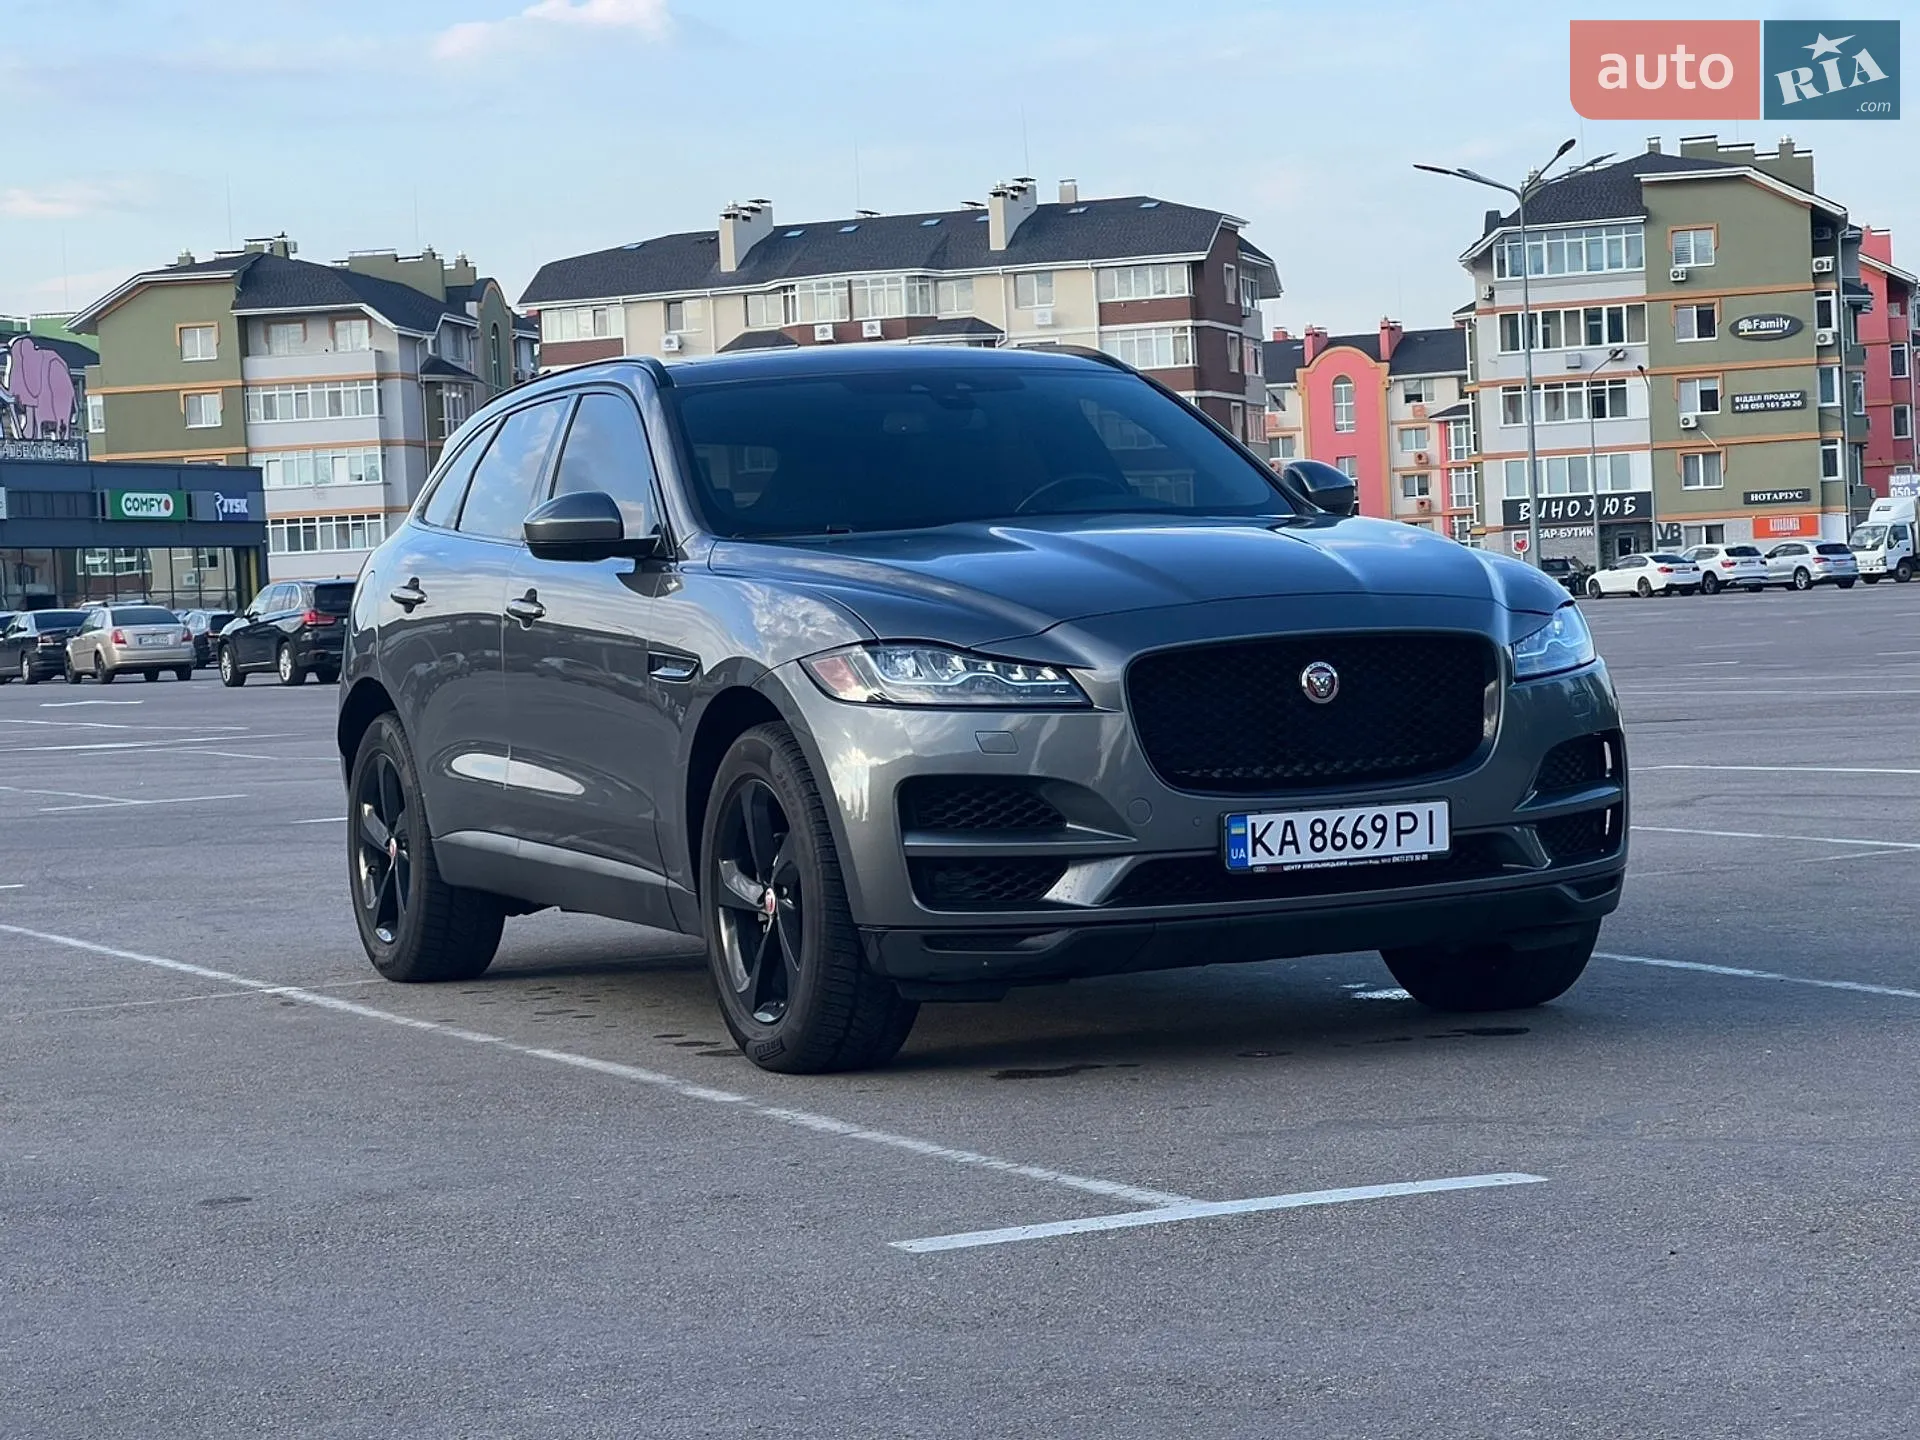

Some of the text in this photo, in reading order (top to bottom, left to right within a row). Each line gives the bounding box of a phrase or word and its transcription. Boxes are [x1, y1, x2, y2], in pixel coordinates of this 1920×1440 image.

[1753, 317, 1790, 330] Family
[1735, 392, 1801, 403] ВІДДІЛ ПРОДАЖУ
[1750, 490, 1803, 501] НОТАРІУС
[124, 497, 163, 512] COMFY
[222, 498, 249, 513] JYSK
[1231, 847, 1246, 860] UA
